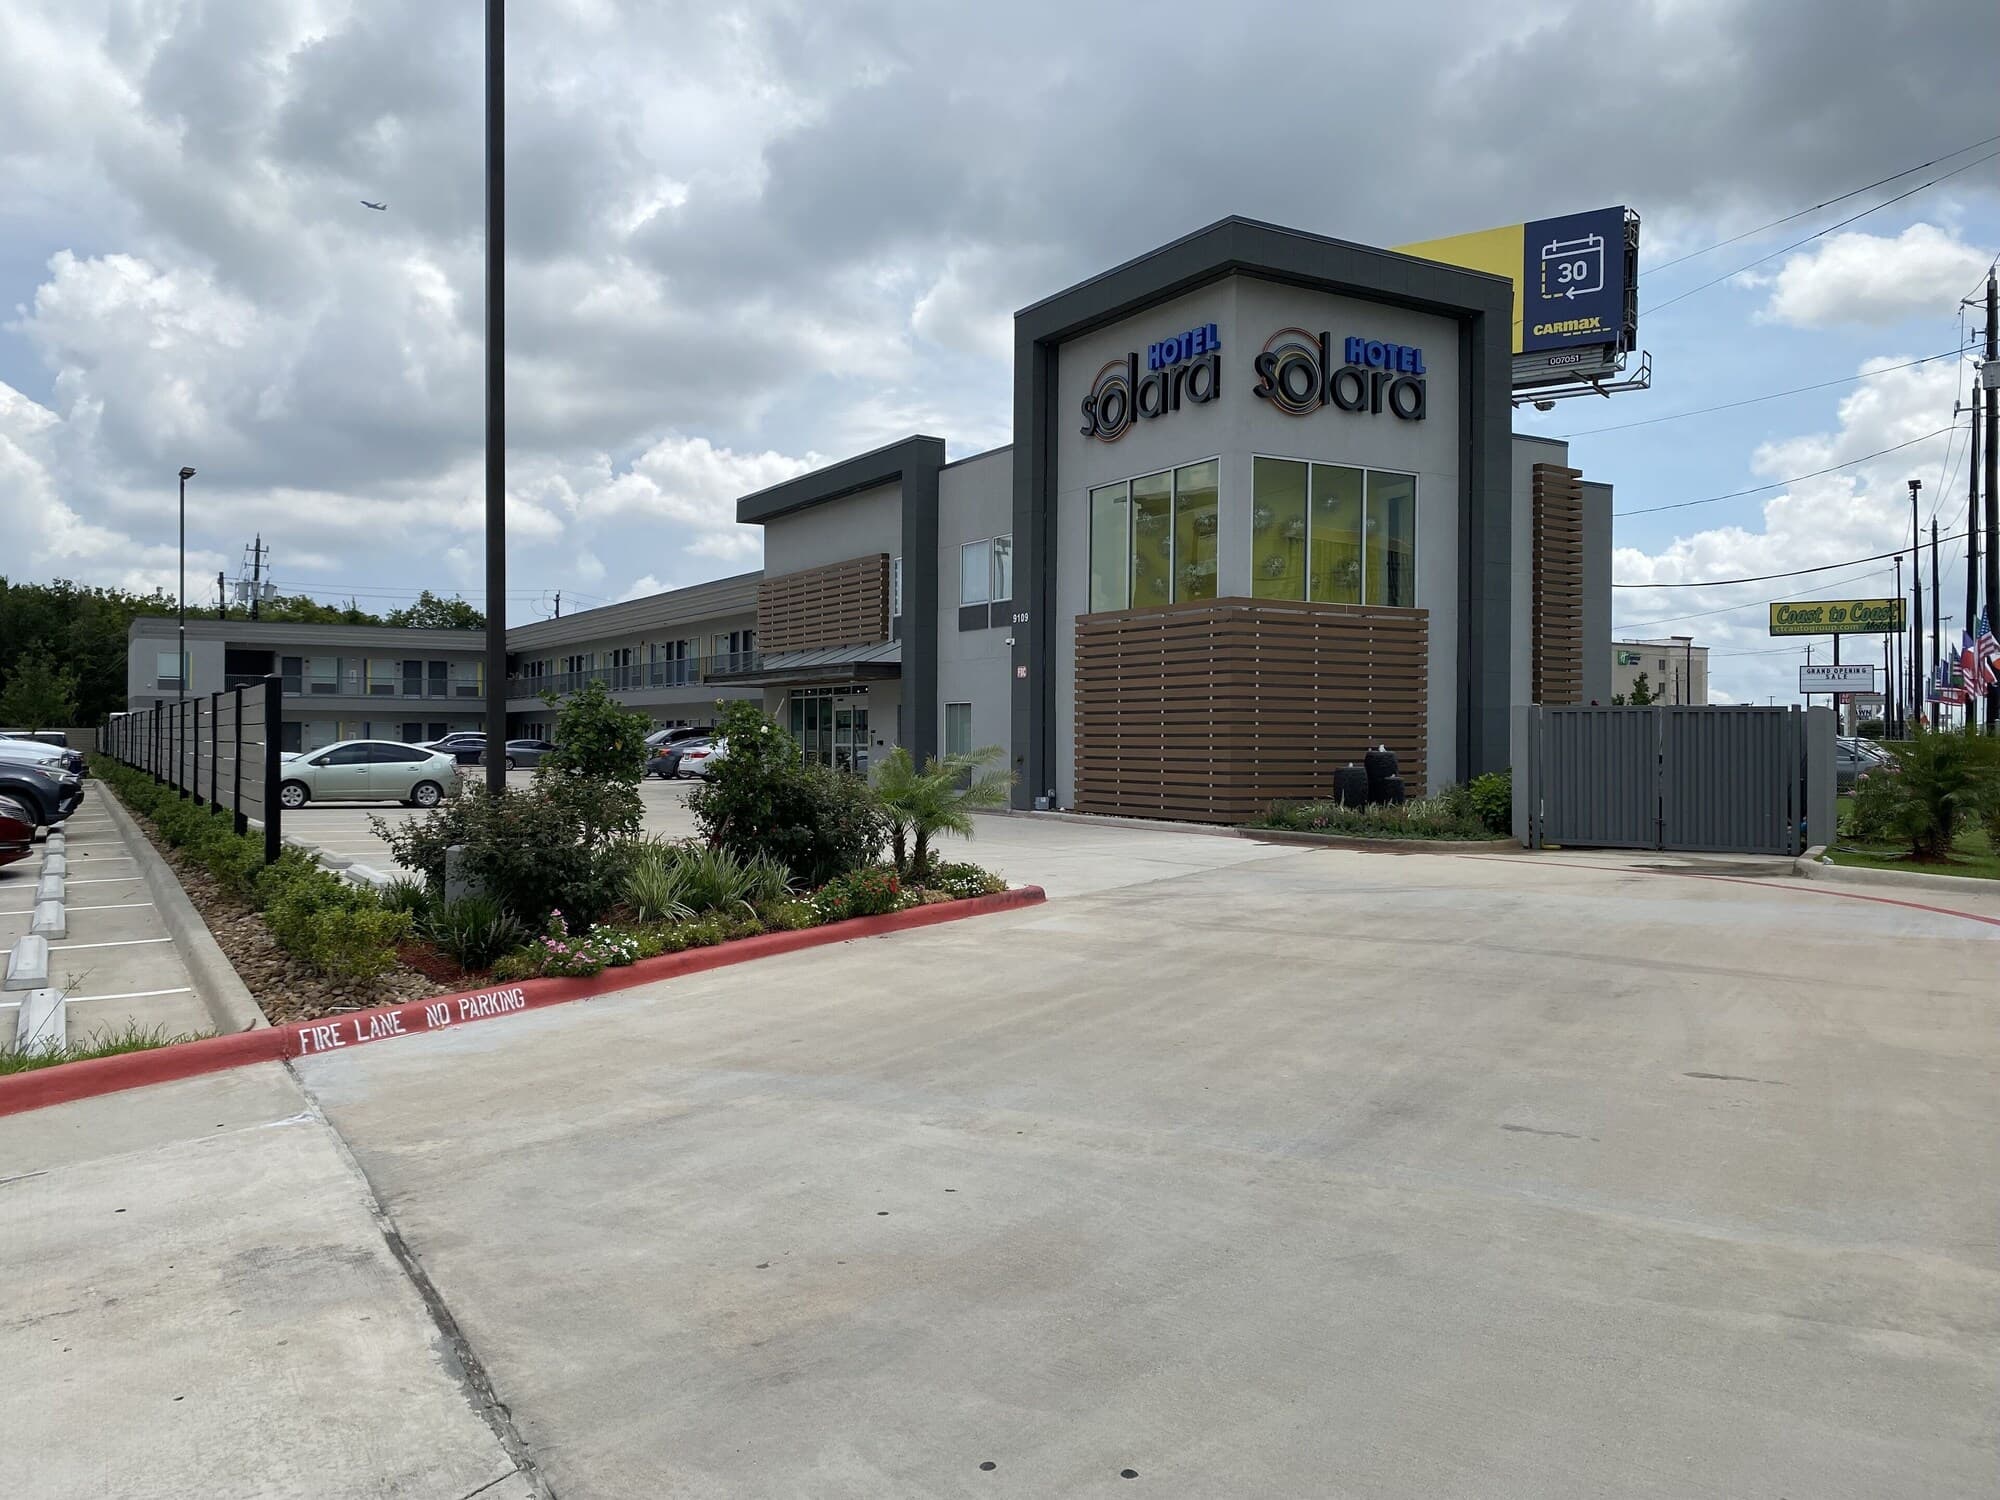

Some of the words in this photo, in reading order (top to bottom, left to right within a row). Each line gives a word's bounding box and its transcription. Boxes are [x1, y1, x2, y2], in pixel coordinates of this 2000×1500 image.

[1558, 260, 1587, 283] 30
[1148, 323, 1221, 370] HOTEL
[1344, 336, 1426, 374] HOTEL
[1549, 355, 1580, 365] 007051
[1253, 331, 1426, 421] solara
[1080, 352, 1221, 436] solara
[1013, 613, 1029, 623] 9109
[1777, 605, 1823, 624] Coast
[1829, 606, 1847, 622] to
[1850, 602, 1899, 622] Coast
[1775, 625, 1859, 633] ctcautogroup.com
[1863, 621, 1899, 631] Motos
[299, 1023, 346, 1054] FIRE
[353, 1010, 406, 1042] LANE
[425, 1003, 451, 1028] NO
[457, 987, 526, 1020] PARKING
